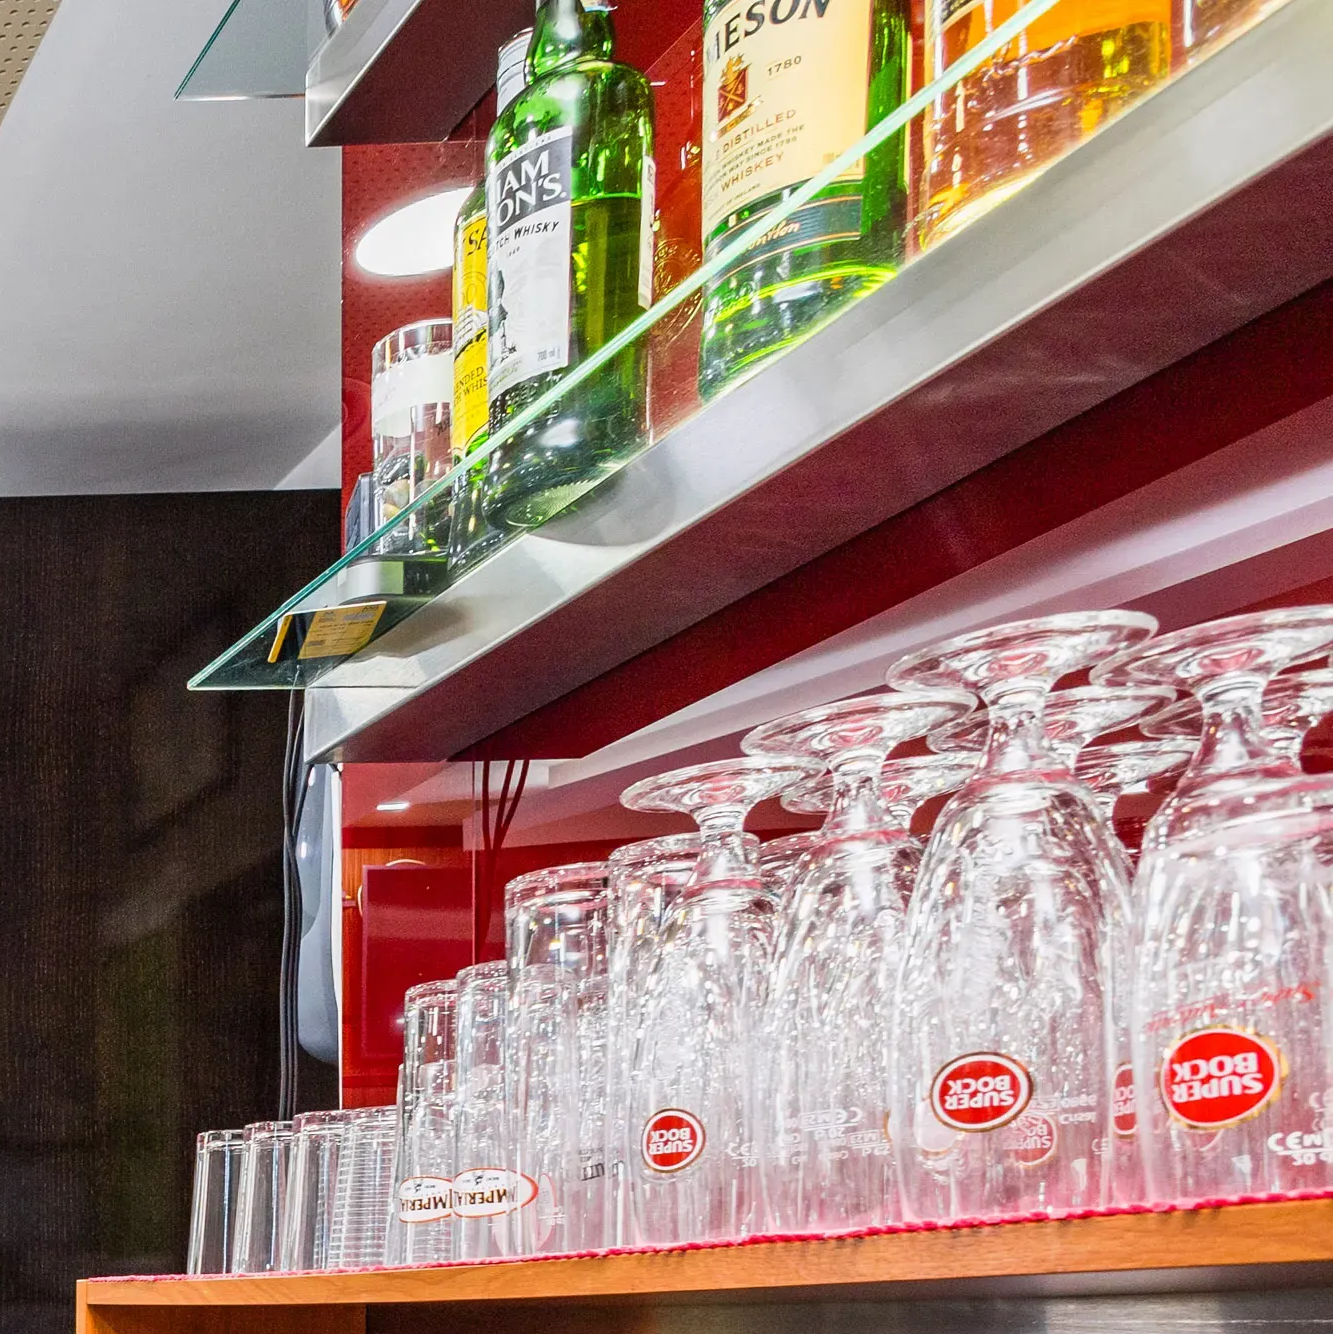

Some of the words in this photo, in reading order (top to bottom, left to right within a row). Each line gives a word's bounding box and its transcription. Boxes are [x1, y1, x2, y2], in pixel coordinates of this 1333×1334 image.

[767, 55, 803, 76] 1780
[722, 109, 797, 154] DISTILLED
[756, 132, 783, 148] MADE
[786, 124, 806, 135] THE
[720, 152, 785, 192] WHISKEY
[512, 220, 560, 242] WHISKY
[1173, 1052, 1259, 1083] BOCK
[948, 1075, 1012, 1095] BOCK
[1172, 1073, 1264, 1104] SUPER
[945, 1090, 1015, 1111] SUPER
[650, 1127, 691, 1143] BOCK
[649, 1139, 694, 1156] SUPER
